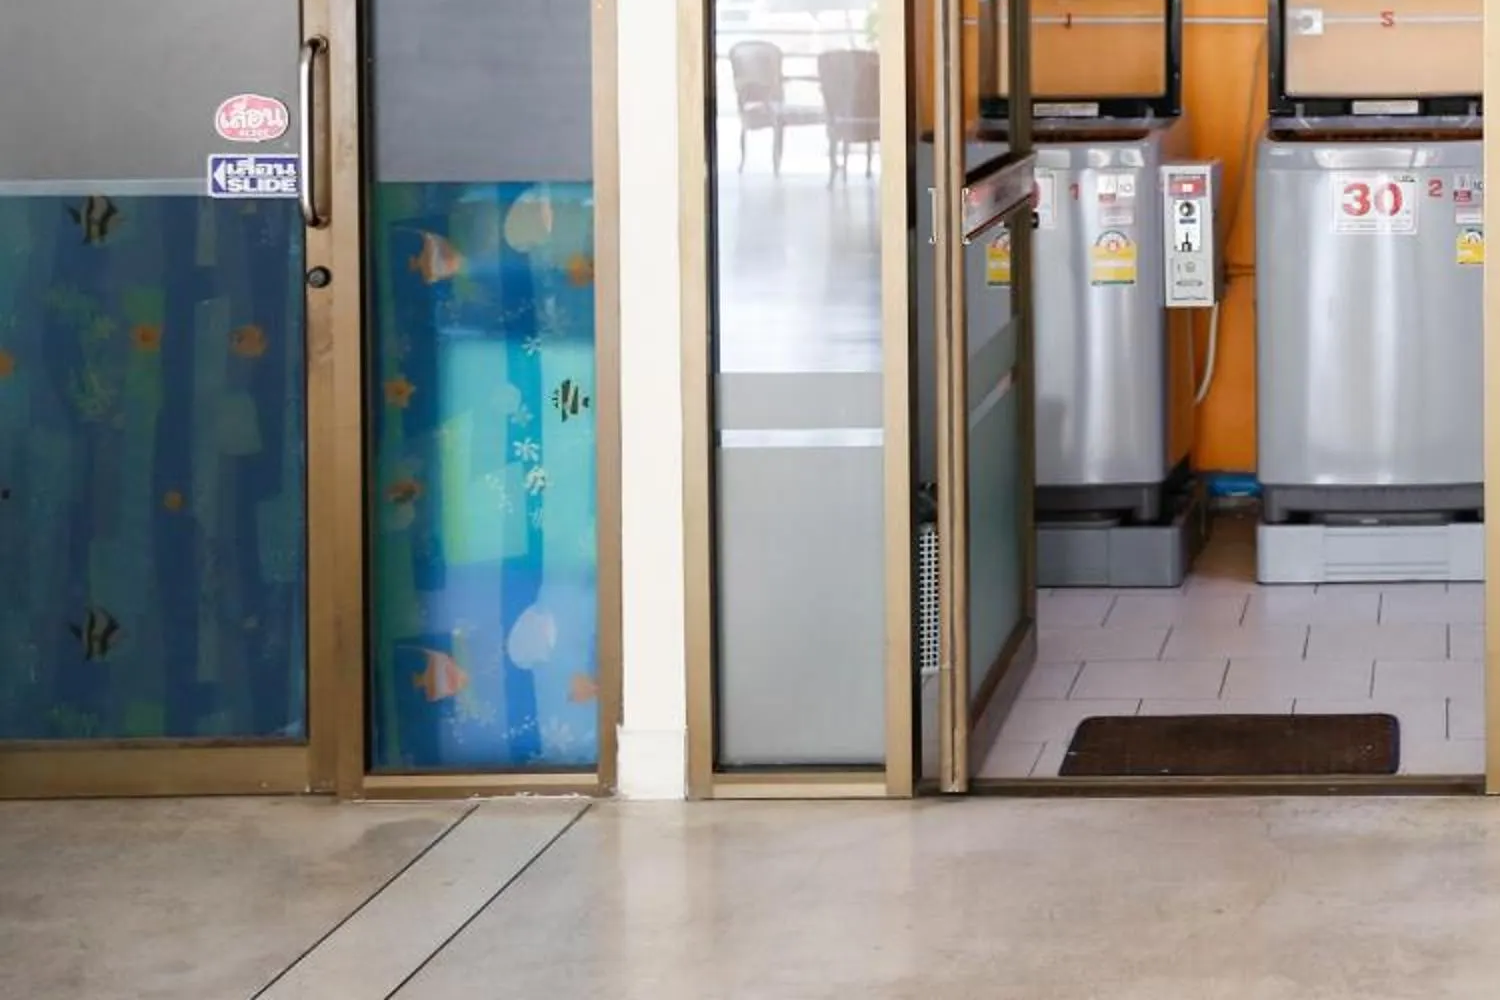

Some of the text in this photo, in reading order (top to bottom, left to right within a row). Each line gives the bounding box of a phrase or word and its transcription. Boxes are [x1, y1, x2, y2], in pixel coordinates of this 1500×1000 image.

[227, 178, 297, 192] SLIDE
[1428, 179, 1443, 197] 2
[1342, 182, 1404, 217] 30
